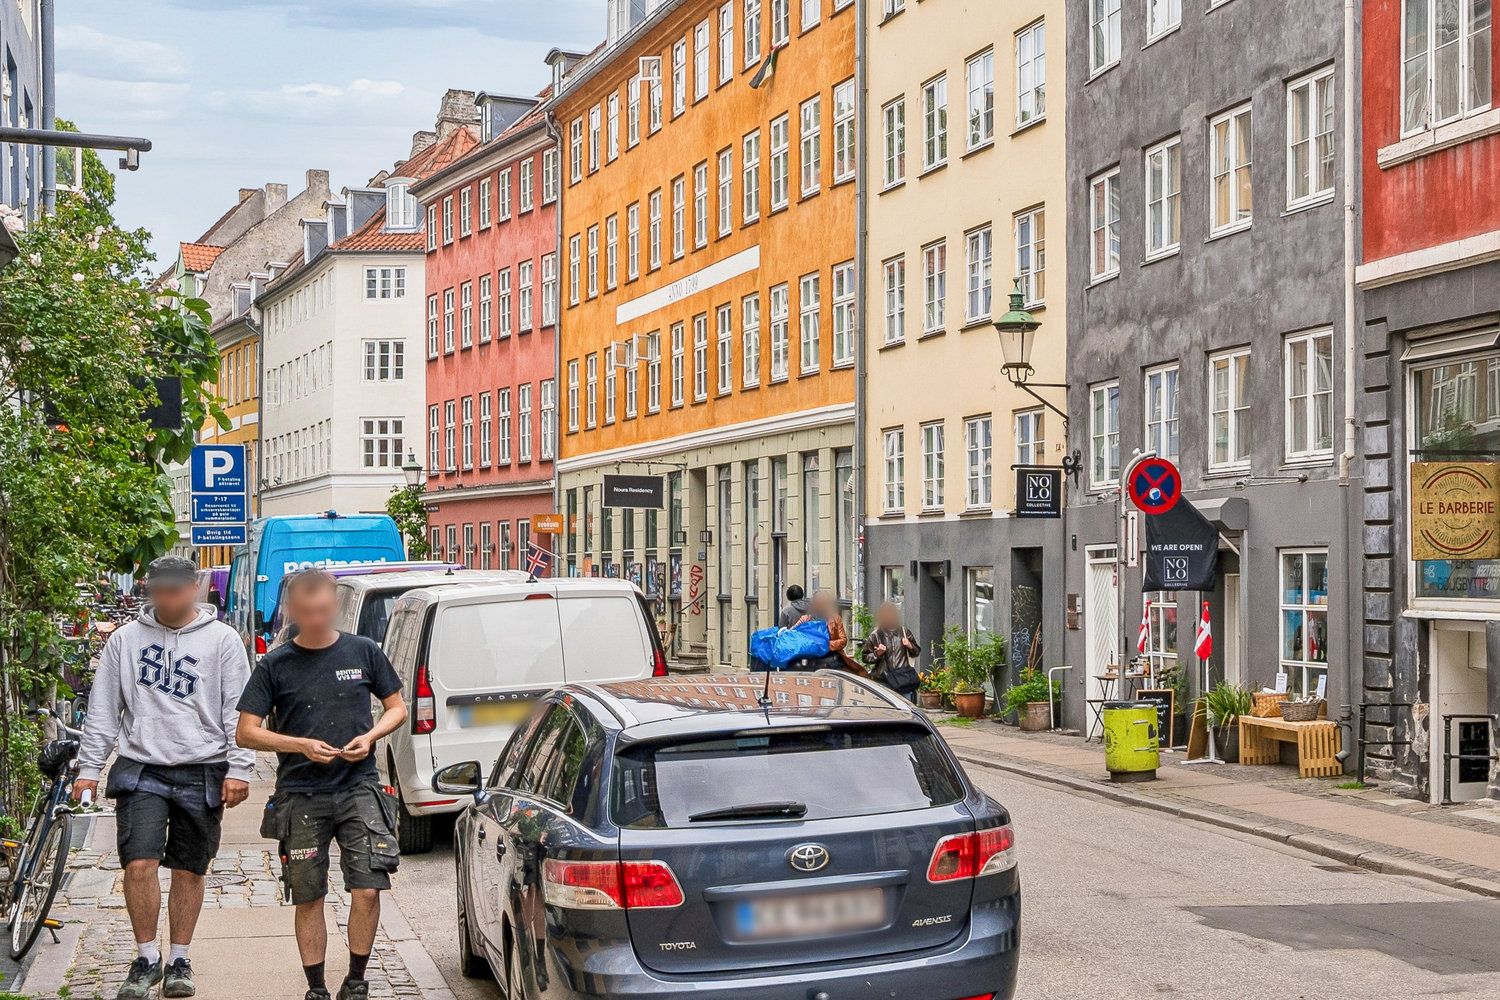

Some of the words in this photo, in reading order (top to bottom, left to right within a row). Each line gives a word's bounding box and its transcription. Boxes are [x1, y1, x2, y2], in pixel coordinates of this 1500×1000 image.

[204, 450, 234, 488] P
[1029, 476, 1050, 488] NO
[1029, 487, 1050, 499] LO
[1420, 502, 1433, 514] LE
[1438, 501, 1495, 514] BARBERIE
[1166, 558, 1187, 569] NO
[1166, 569, 1187, 580] LO
[475, 693, 529, 702] CADDY
[912, 914, 952, 928] AVENSIS
[659, 941, 697, 952] TOYOTA
